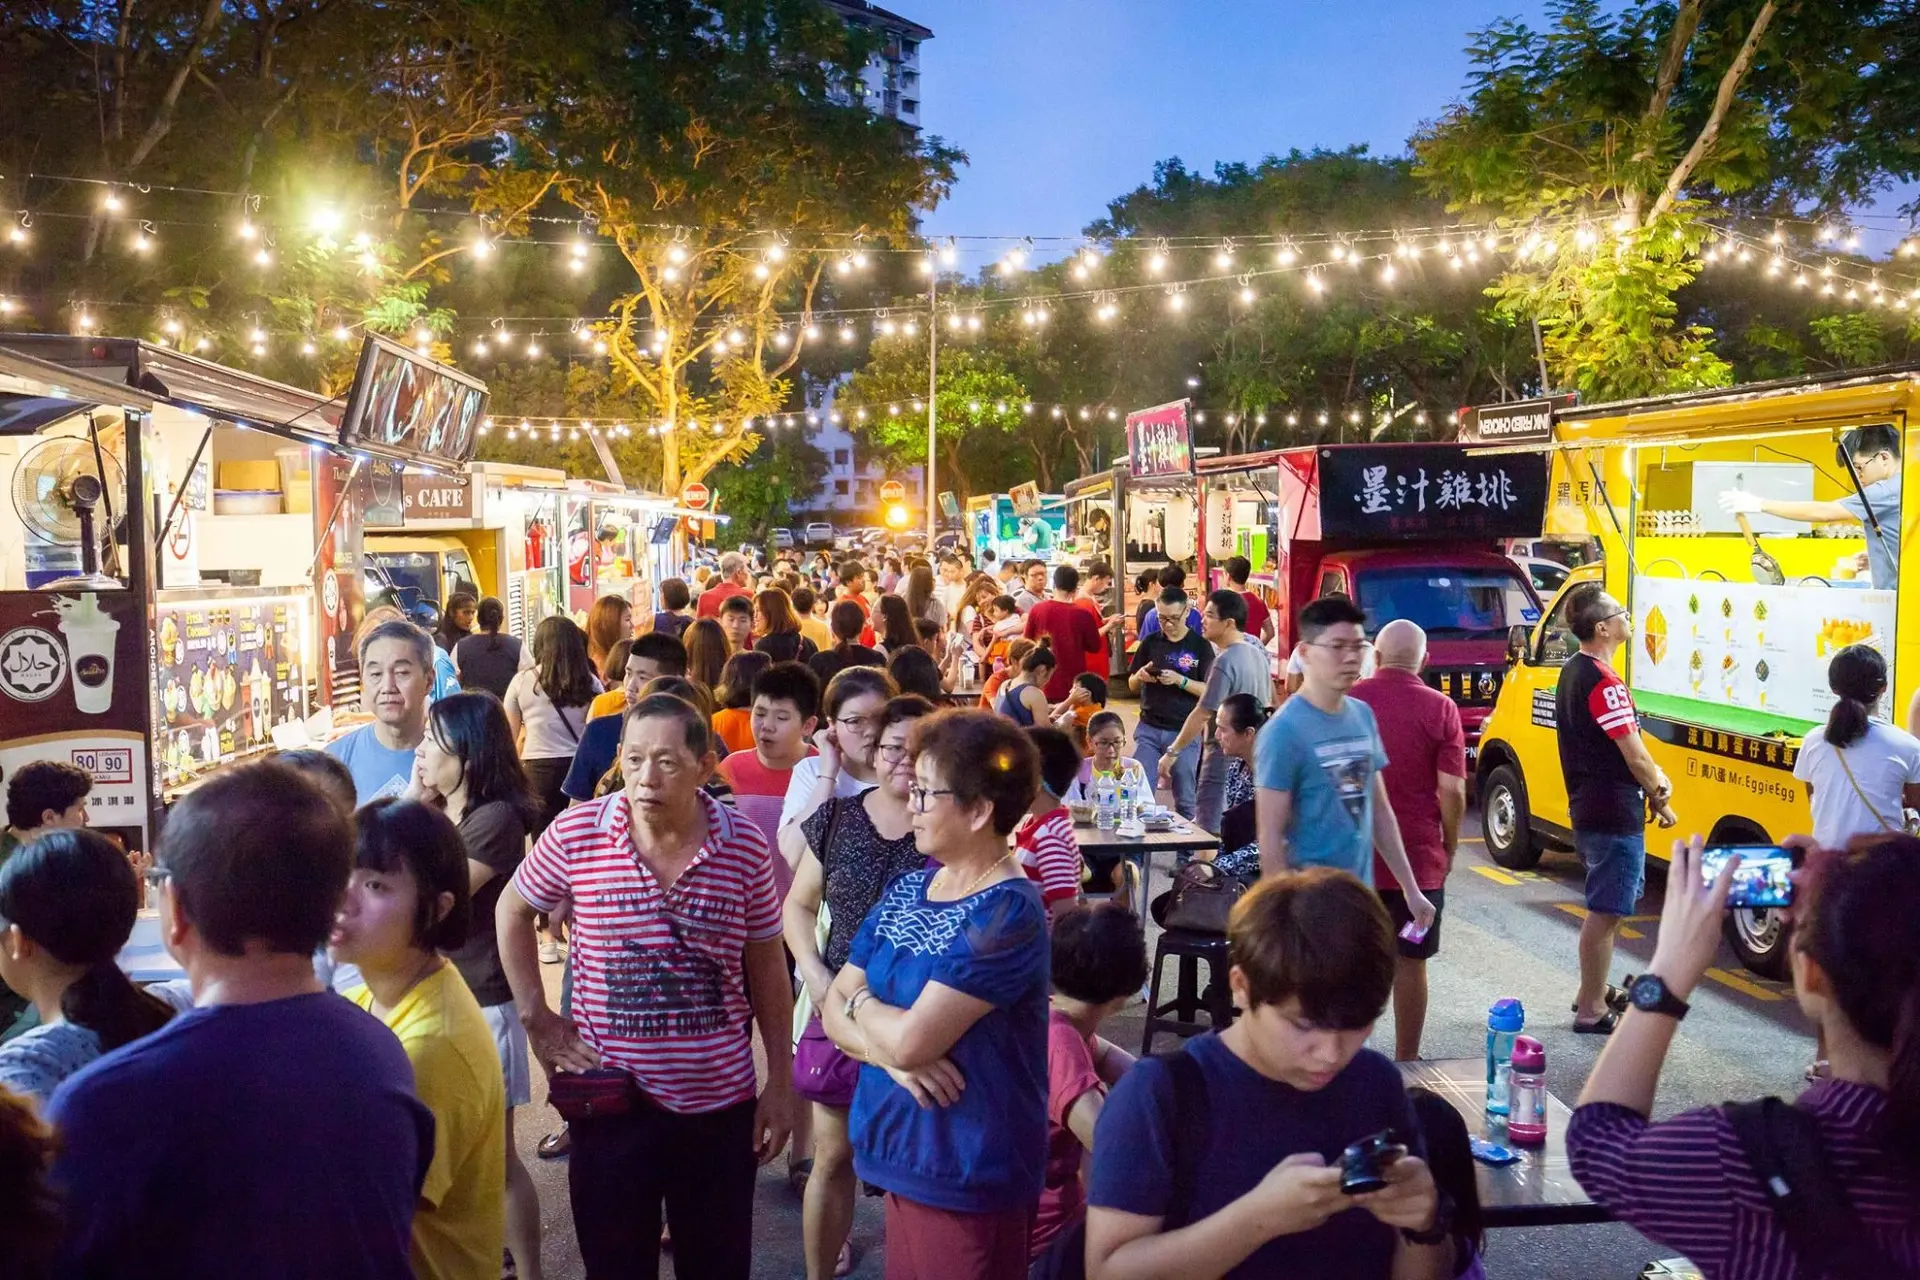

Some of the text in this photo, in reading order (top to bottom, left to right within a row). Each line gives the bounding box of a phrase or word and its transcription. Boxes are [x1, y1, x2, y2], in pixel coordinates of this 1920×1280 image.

[1479, 417, 1510, 435] CHICKEN
[418, 488, 464, 507] CAFE
[1354, 464, 1518, 514] 墨汁雞排
[10, 651, 52, 673] حلال
[1602, 684, 1629, 711] 85
[1463, 746, 1477, 759] PN
[105, 757, 122, 770] 90
